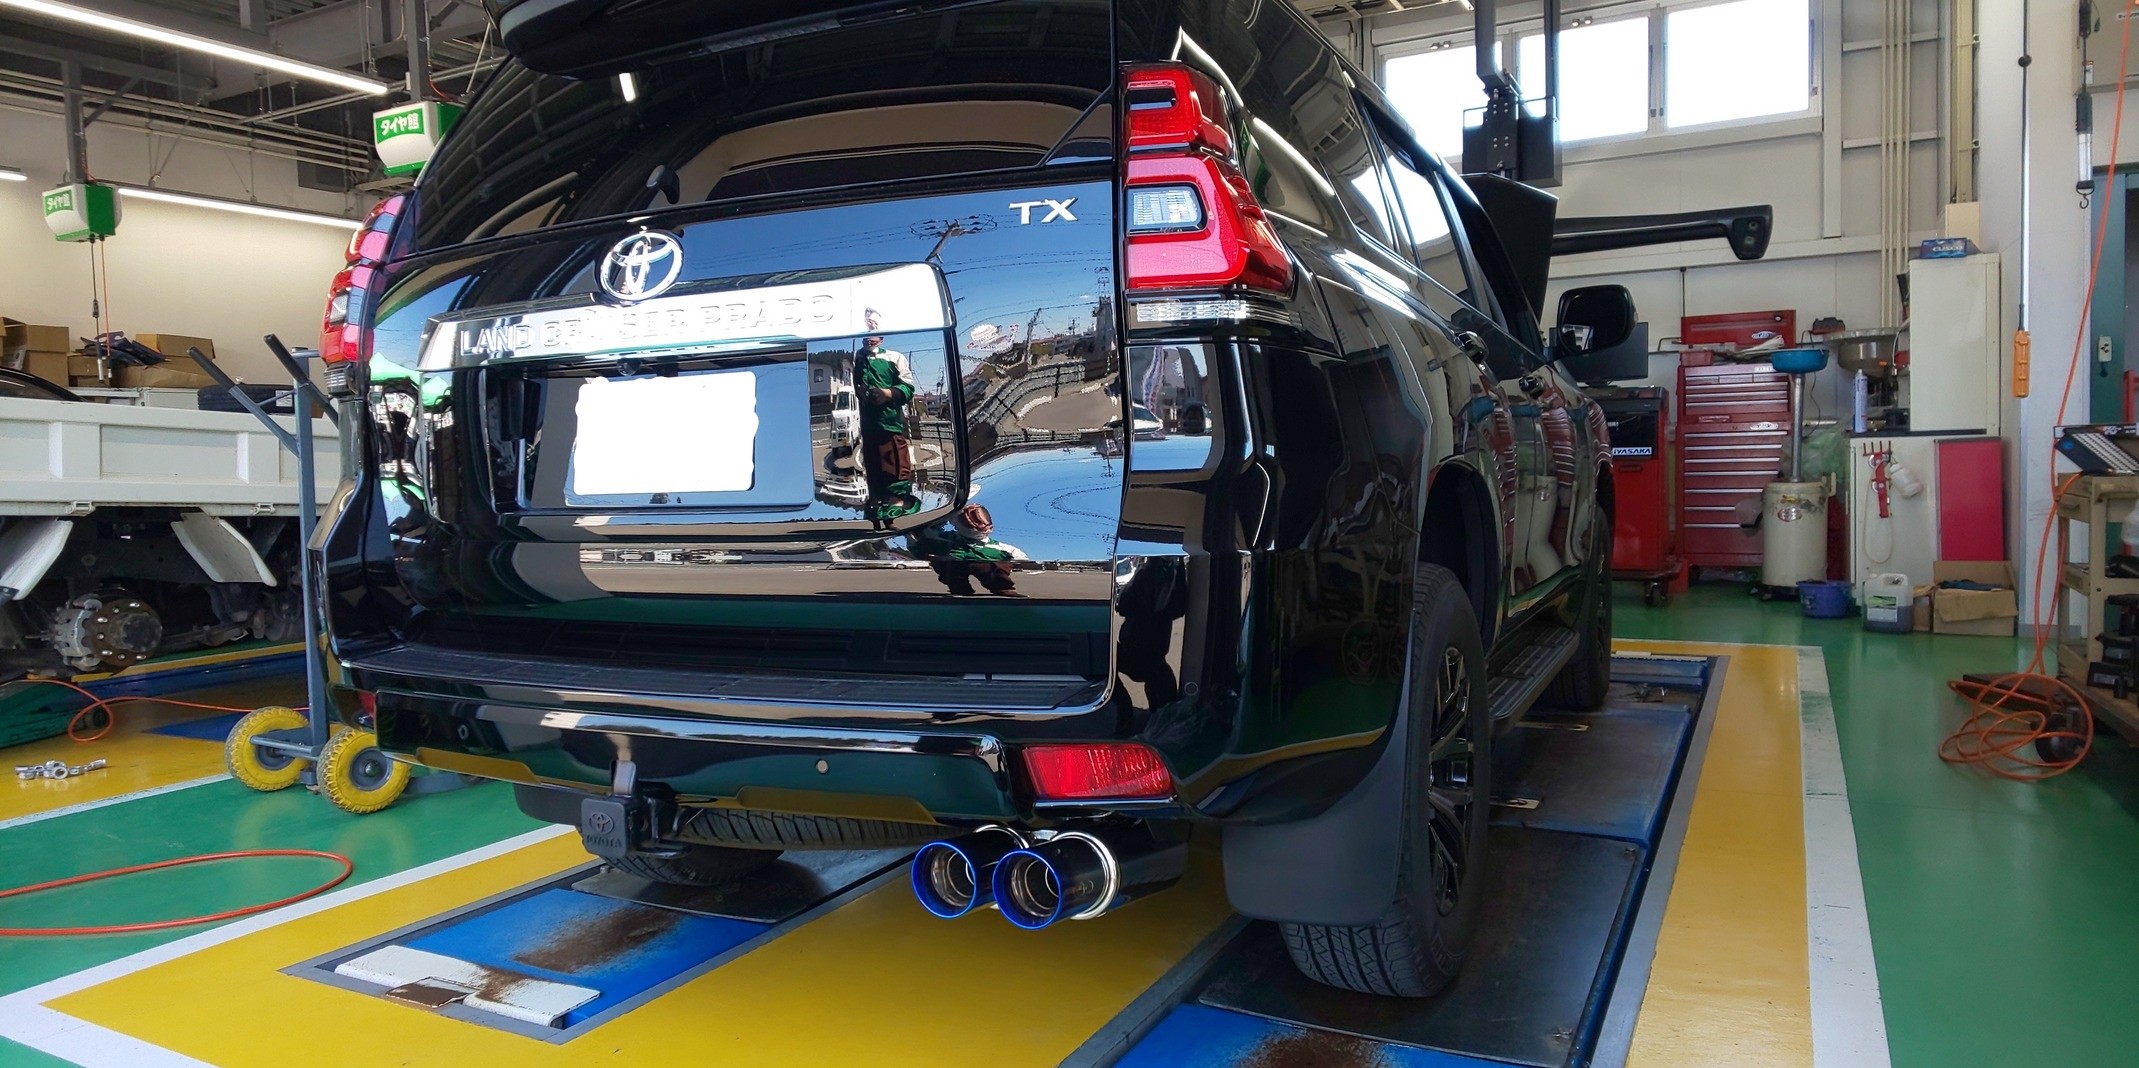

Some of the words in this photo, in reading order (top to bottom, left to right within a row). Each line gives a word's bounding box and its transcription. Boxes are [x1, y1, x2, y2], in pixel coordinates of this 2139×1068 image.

[381, 112, 420, 136] タイヤ館
[1008, 197, 1079, 226] TX
[460, 324, 532, 356] LAND
[539, 308, 686, 348] CRSER
